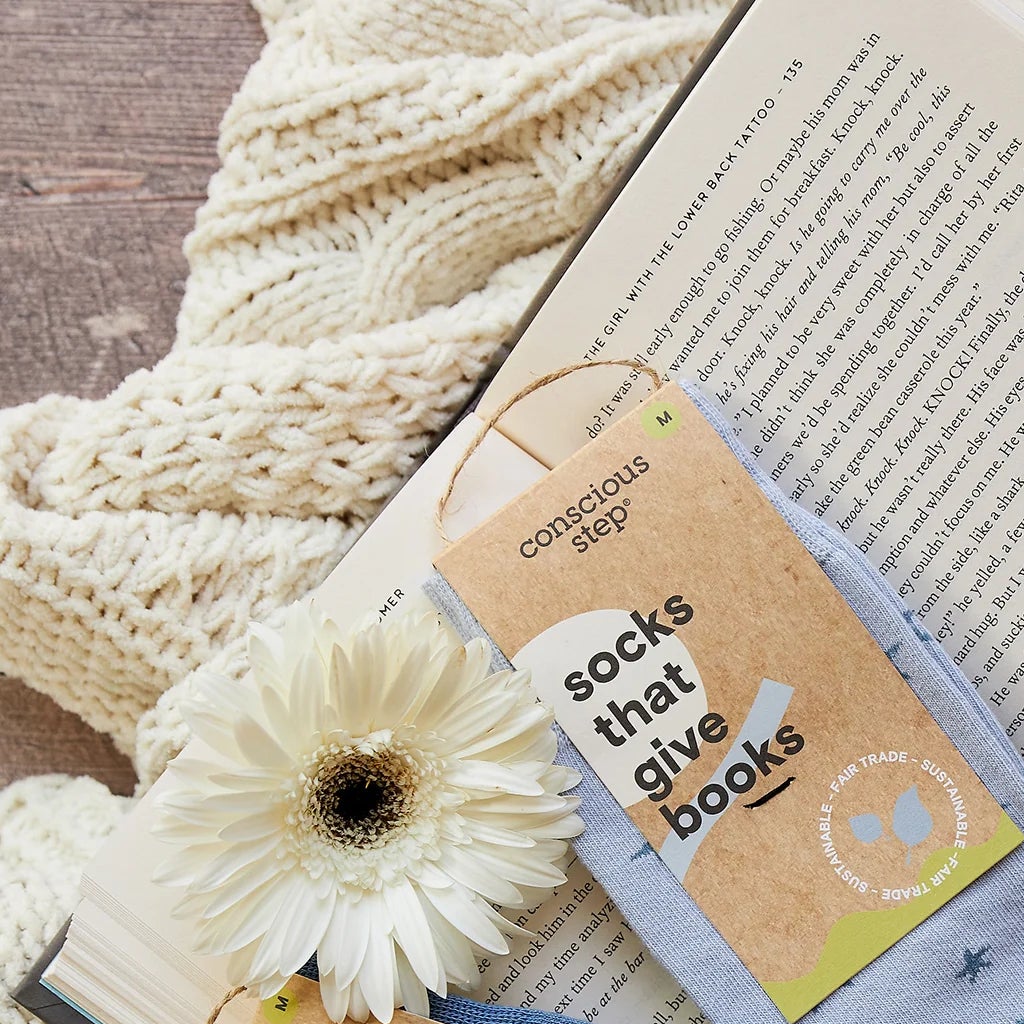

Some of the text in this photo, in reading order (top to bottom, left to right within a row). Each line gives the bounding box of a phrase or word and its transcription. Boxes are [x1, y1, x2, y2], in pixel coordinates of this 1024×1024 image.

[585, 33, 880, 439] do? It was early enough to go fishing. Or maybe his mom was in
[603, 307, 629, 335] GIRL
[625, 268, 653, 301] WITH
[650, 240, 674, 266] THE
[670, 191, 708, 239] LOWER
[705, 151, 737, 190] BACK
[733, 98, 774, 148] TATTOO
[782, 58, 802, 81] 135
[668, 53, 903, 371] wanted me to join them for breakfast. Knock, knock.
[696, 67, 927, 382] door. Knock, knock. Is he going to carry me over the
[740, 102, 975, 418] I planned to be very sweet with her but also to assert
[655, 410, 673, 427] M
[829, 282, 981, 494] the green bean casserole this year.”
[833, 497, 868, 533] knock.
[863, 457, 898, 496] Knock.
[893, 416, 928, 456] Knock.
[921, 349, 973, 415] KNOCK!
[966, 307, 1010, 353] Finally,
[1003, 284, 1023, 305] the
[519, 453, 651, 559] conscious
[934, 572, 954, 592] the
[951, 547, 978, 572] side,
[968, 520, 993, 544] like
[990, 511, 1000, 520] a
[952, 595, 972, 614] he
[968, 554, 1006, 598] yelled,
[1001, 544, 1012, 553] a
[564, 594, 694, 702] socks
[982, 645, 1005, 675] and
[989, 686, 1010, 707] He
[593, 661, 697, 748] that
[633, 712, 729, 803] give
[659, 721, 805, 841] books
[820, 751, 968, 900] FAIR TRADE SUSTAINABLE FAIR TRADE SUSTAINABLE
[499, 965, 520, 992] and
[514, 940, 544, 969] look
[538, 916, 565, 941] him
[560, 903, 577, 917] in
[573, 882, 594, 903] the
[535, 942, 580, 993] my time
[571, 932, 626, 994] time I saw
[583, 952, 647, 1023] be at the bar
[276, 995, 290, 1013] M
